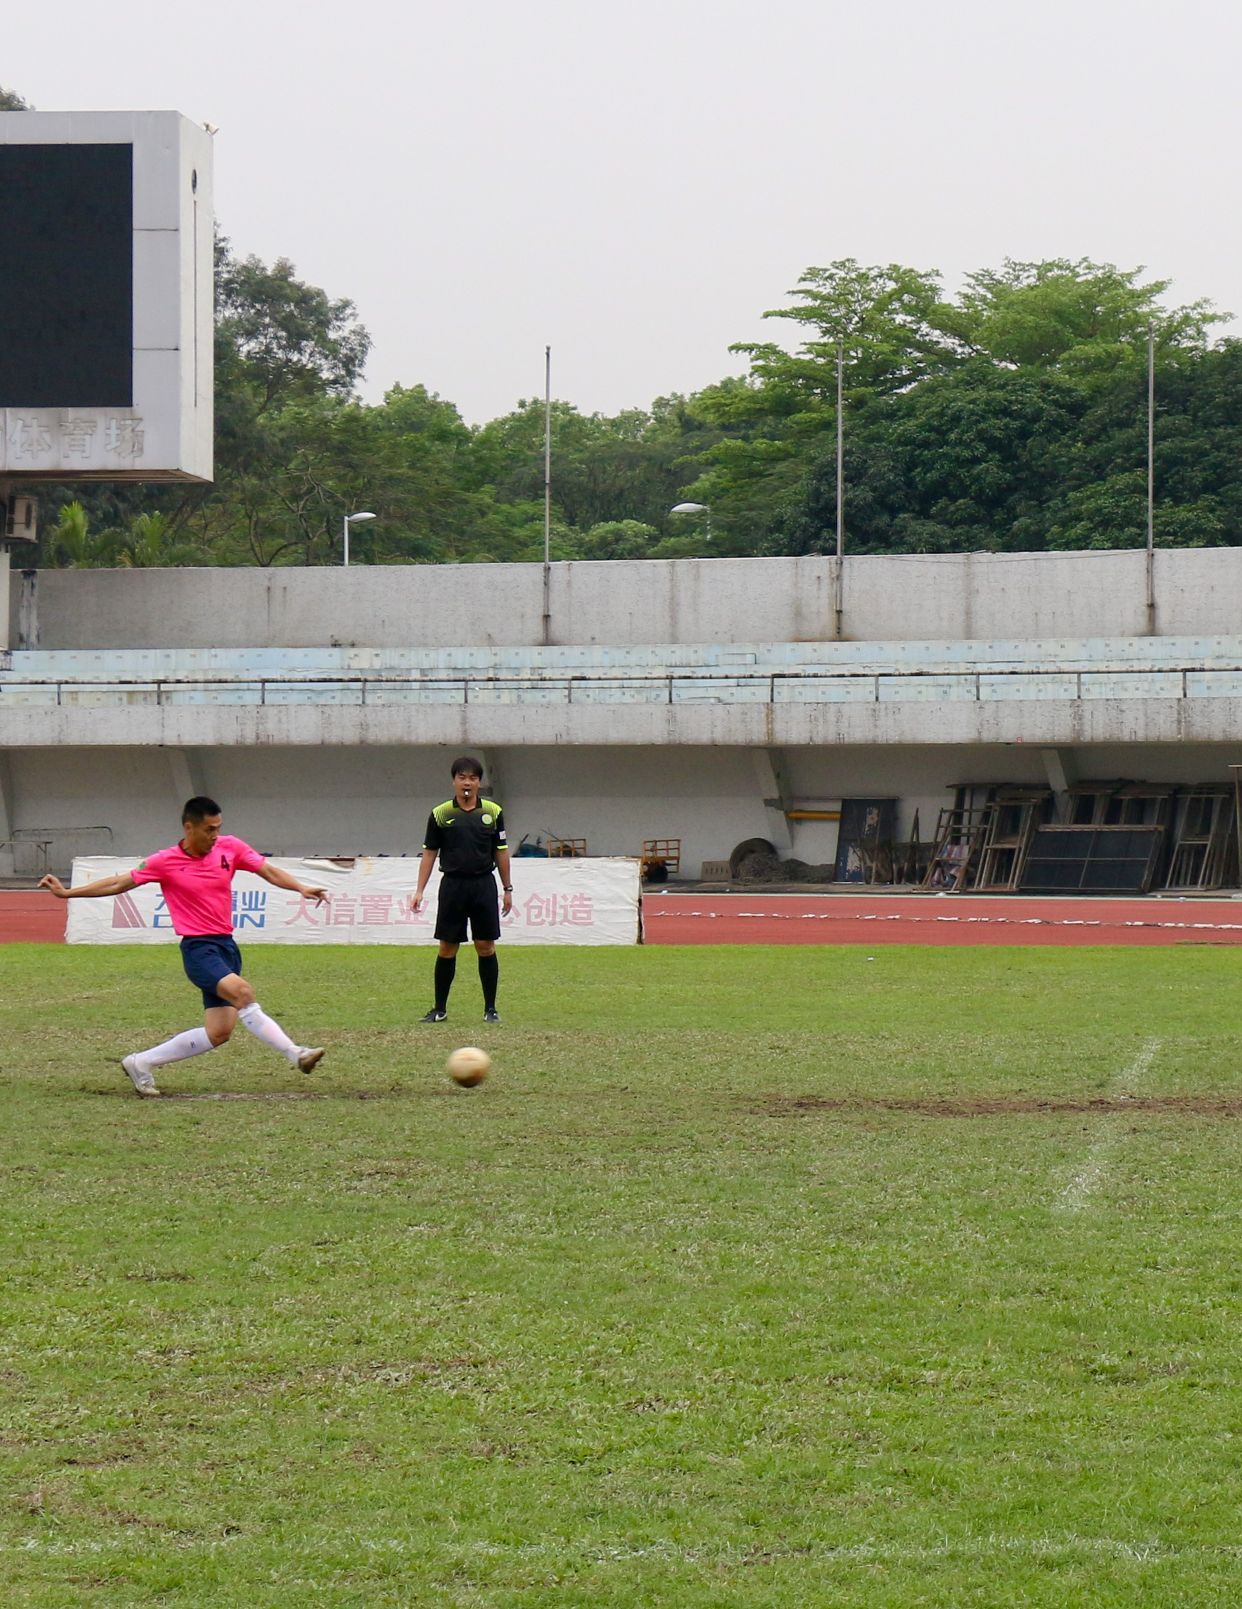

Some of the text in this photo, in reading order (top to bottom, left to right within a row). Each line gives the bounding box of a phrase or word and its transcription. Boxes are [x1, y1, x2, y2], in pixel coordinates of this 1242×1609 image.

[221, 854, 230, 872] 4
[497, 892, 594, 926] 心创造
[153, 914, 265, 928] DIN
